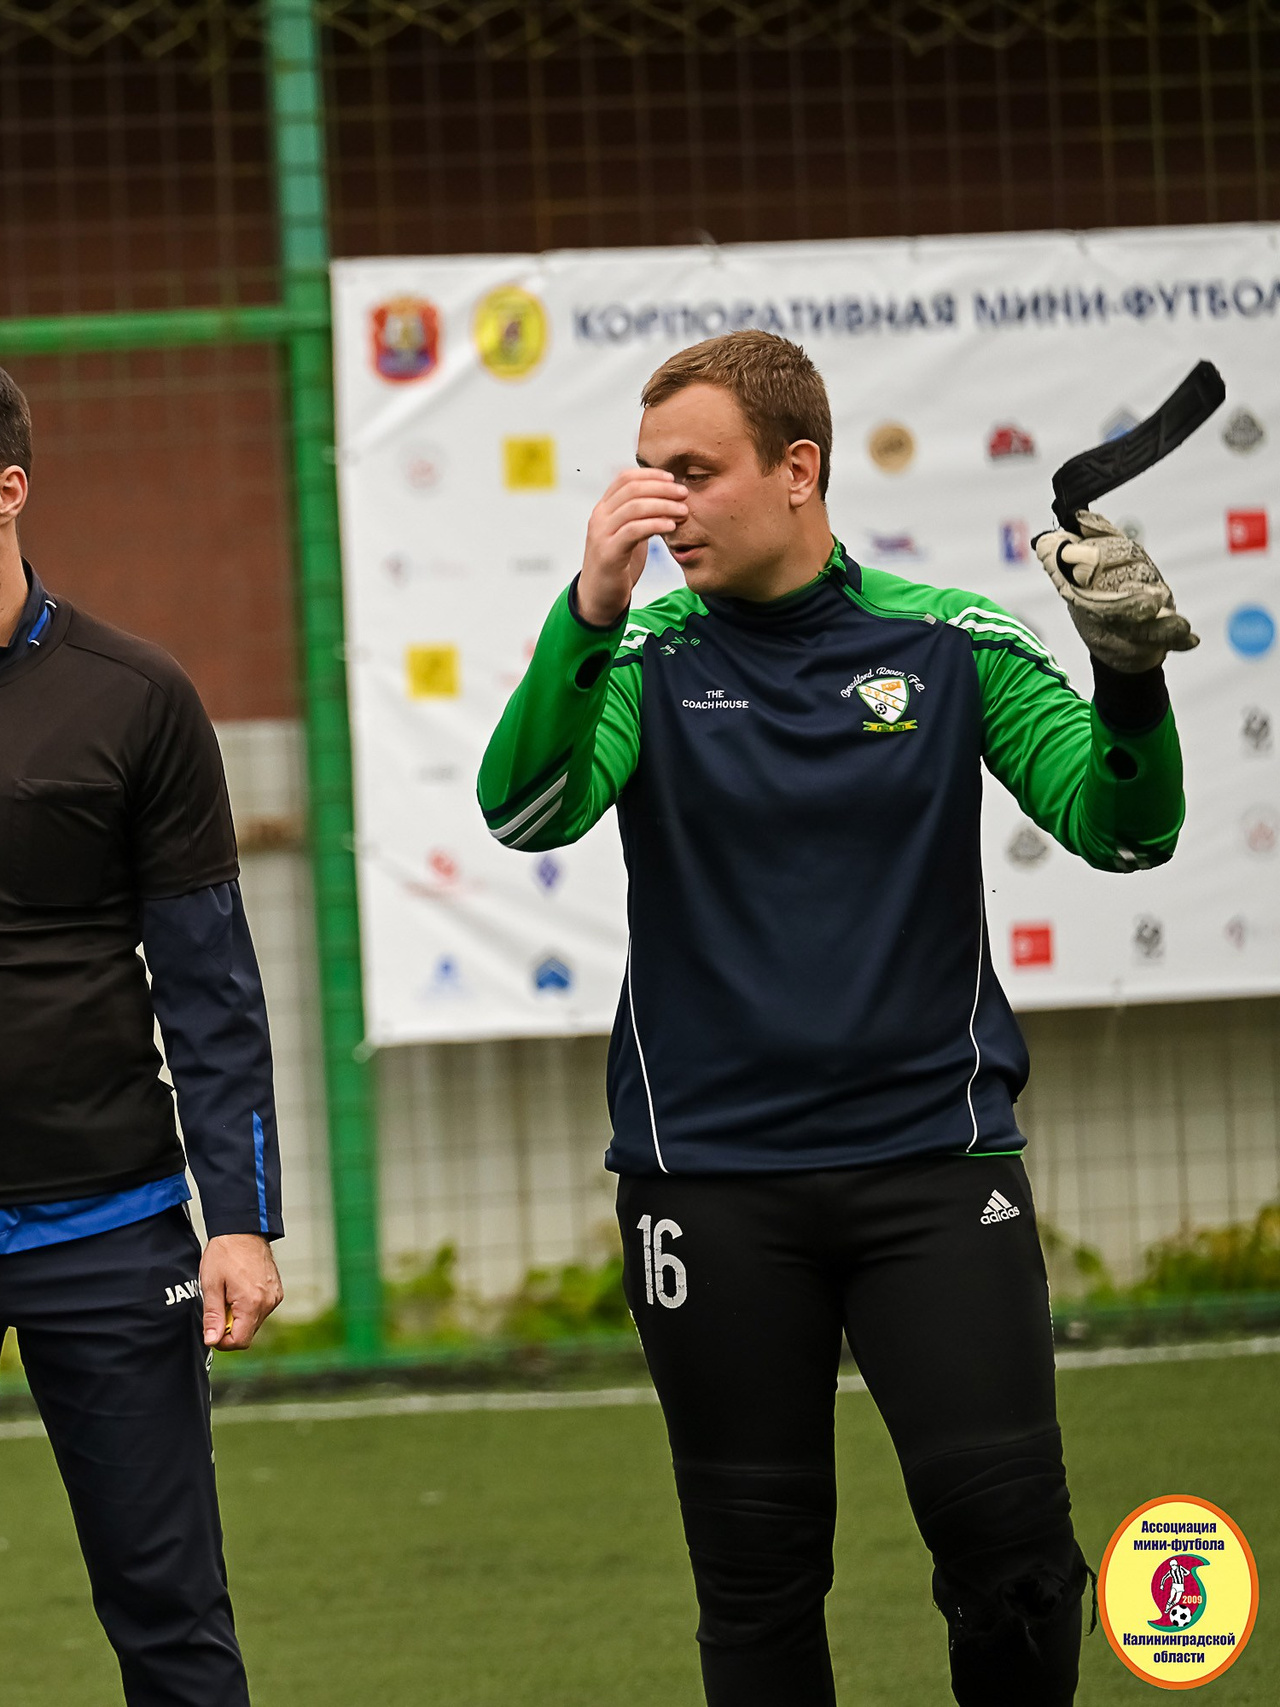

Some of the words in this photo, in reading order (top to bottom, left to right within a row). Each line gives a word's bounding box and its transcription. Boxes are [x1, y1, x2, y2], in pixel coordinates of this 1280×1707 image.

[573, 292, 956, 344] КОРПОРАТИВНАЯ
[705, 689, 725, 699] THE
[980, 1206, 1020, 1225] adidas
[636, 1213, 688, 1309] 16
